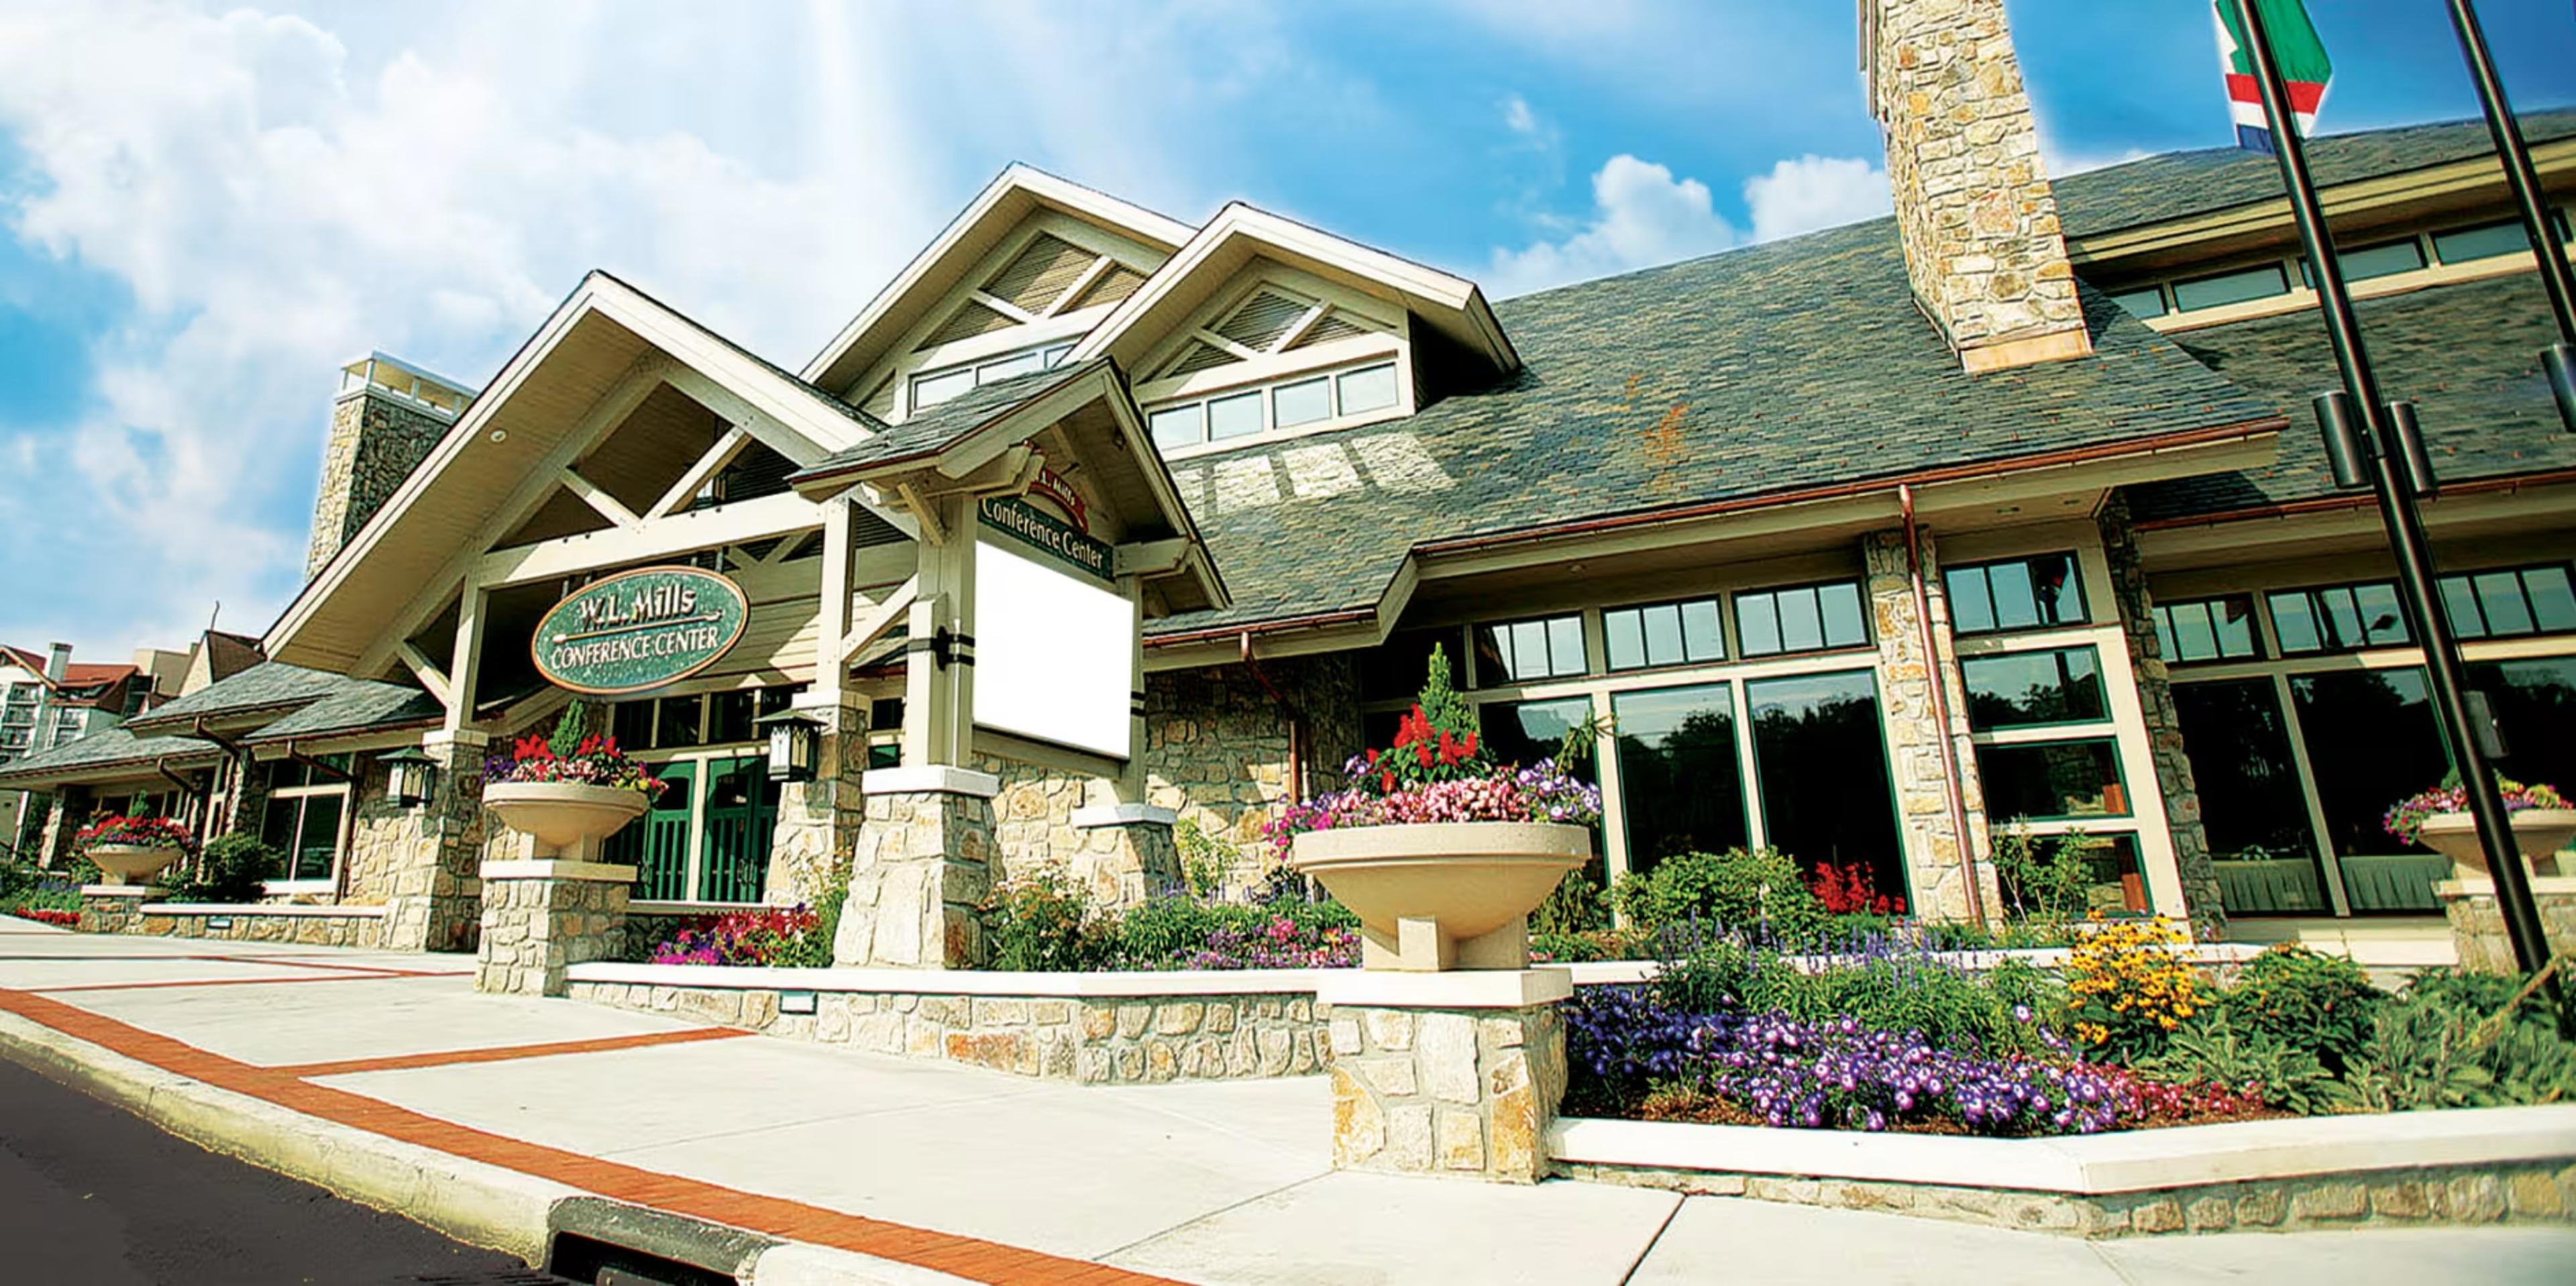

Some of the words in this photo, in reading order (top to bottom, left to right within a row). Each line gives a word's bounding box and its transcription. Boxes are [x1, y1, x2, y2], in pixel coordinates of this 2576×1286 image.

[982, 498, 1060, 549] Conference
[1063, 531, 1102, 569] Center
[631, 583, 696, 621] Mills
[550, 635, 650, 669] CONFERENCE
[655, 626, 718, 655] CENTER
